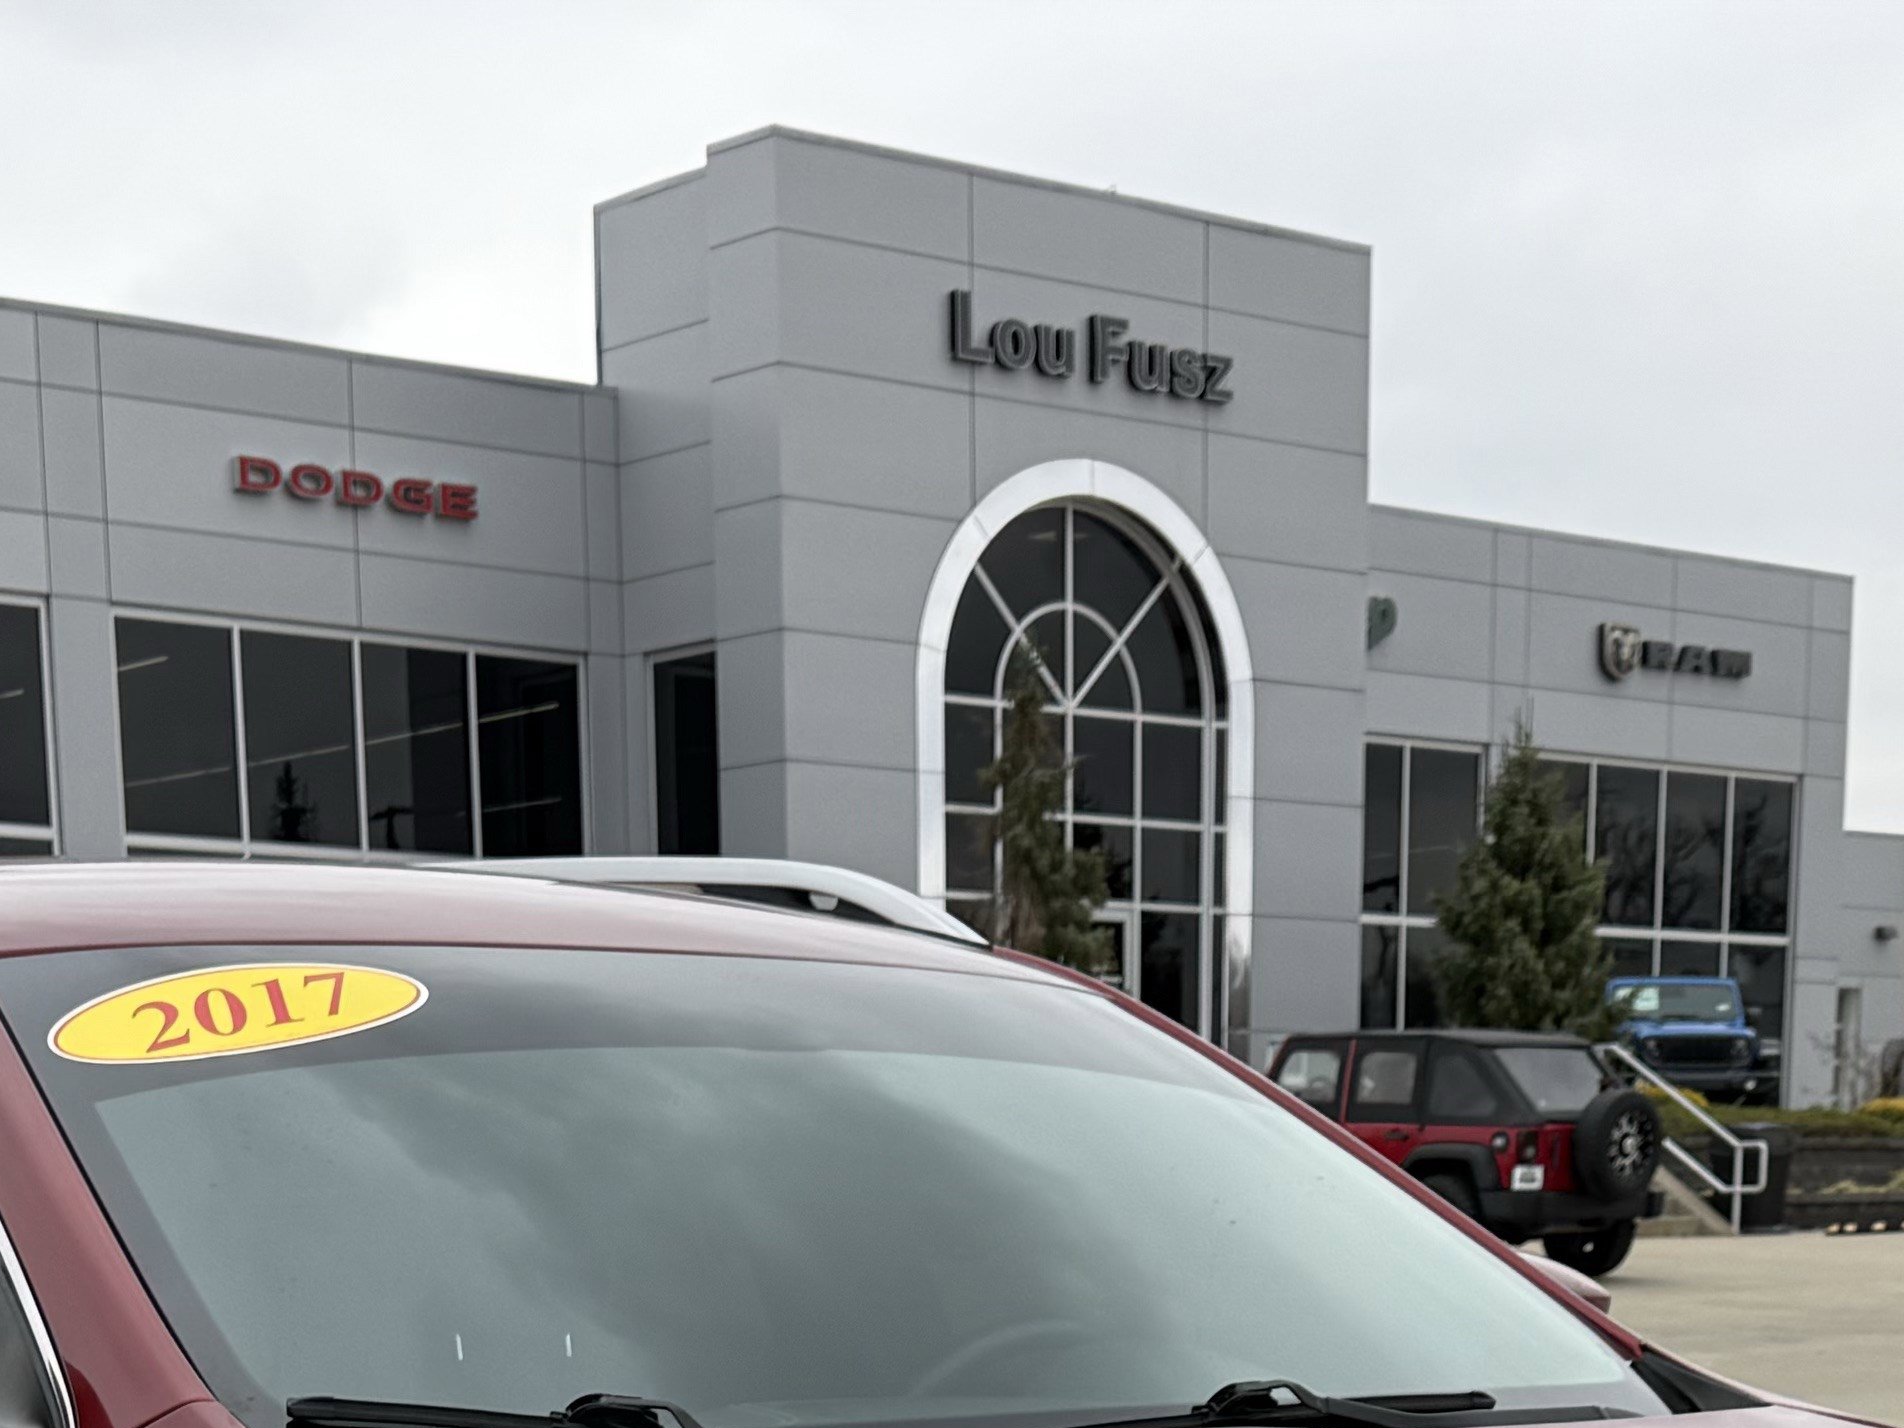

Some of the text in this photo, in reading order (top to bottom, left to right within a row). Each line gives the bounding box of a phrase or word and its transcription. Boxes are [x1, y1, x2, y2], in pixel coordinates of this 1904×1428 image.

[948, 288, 1234, 402] Lou Fusz
[234, 454, 480, 522] DODGE
[130, 970, 346, 1054] 2017
